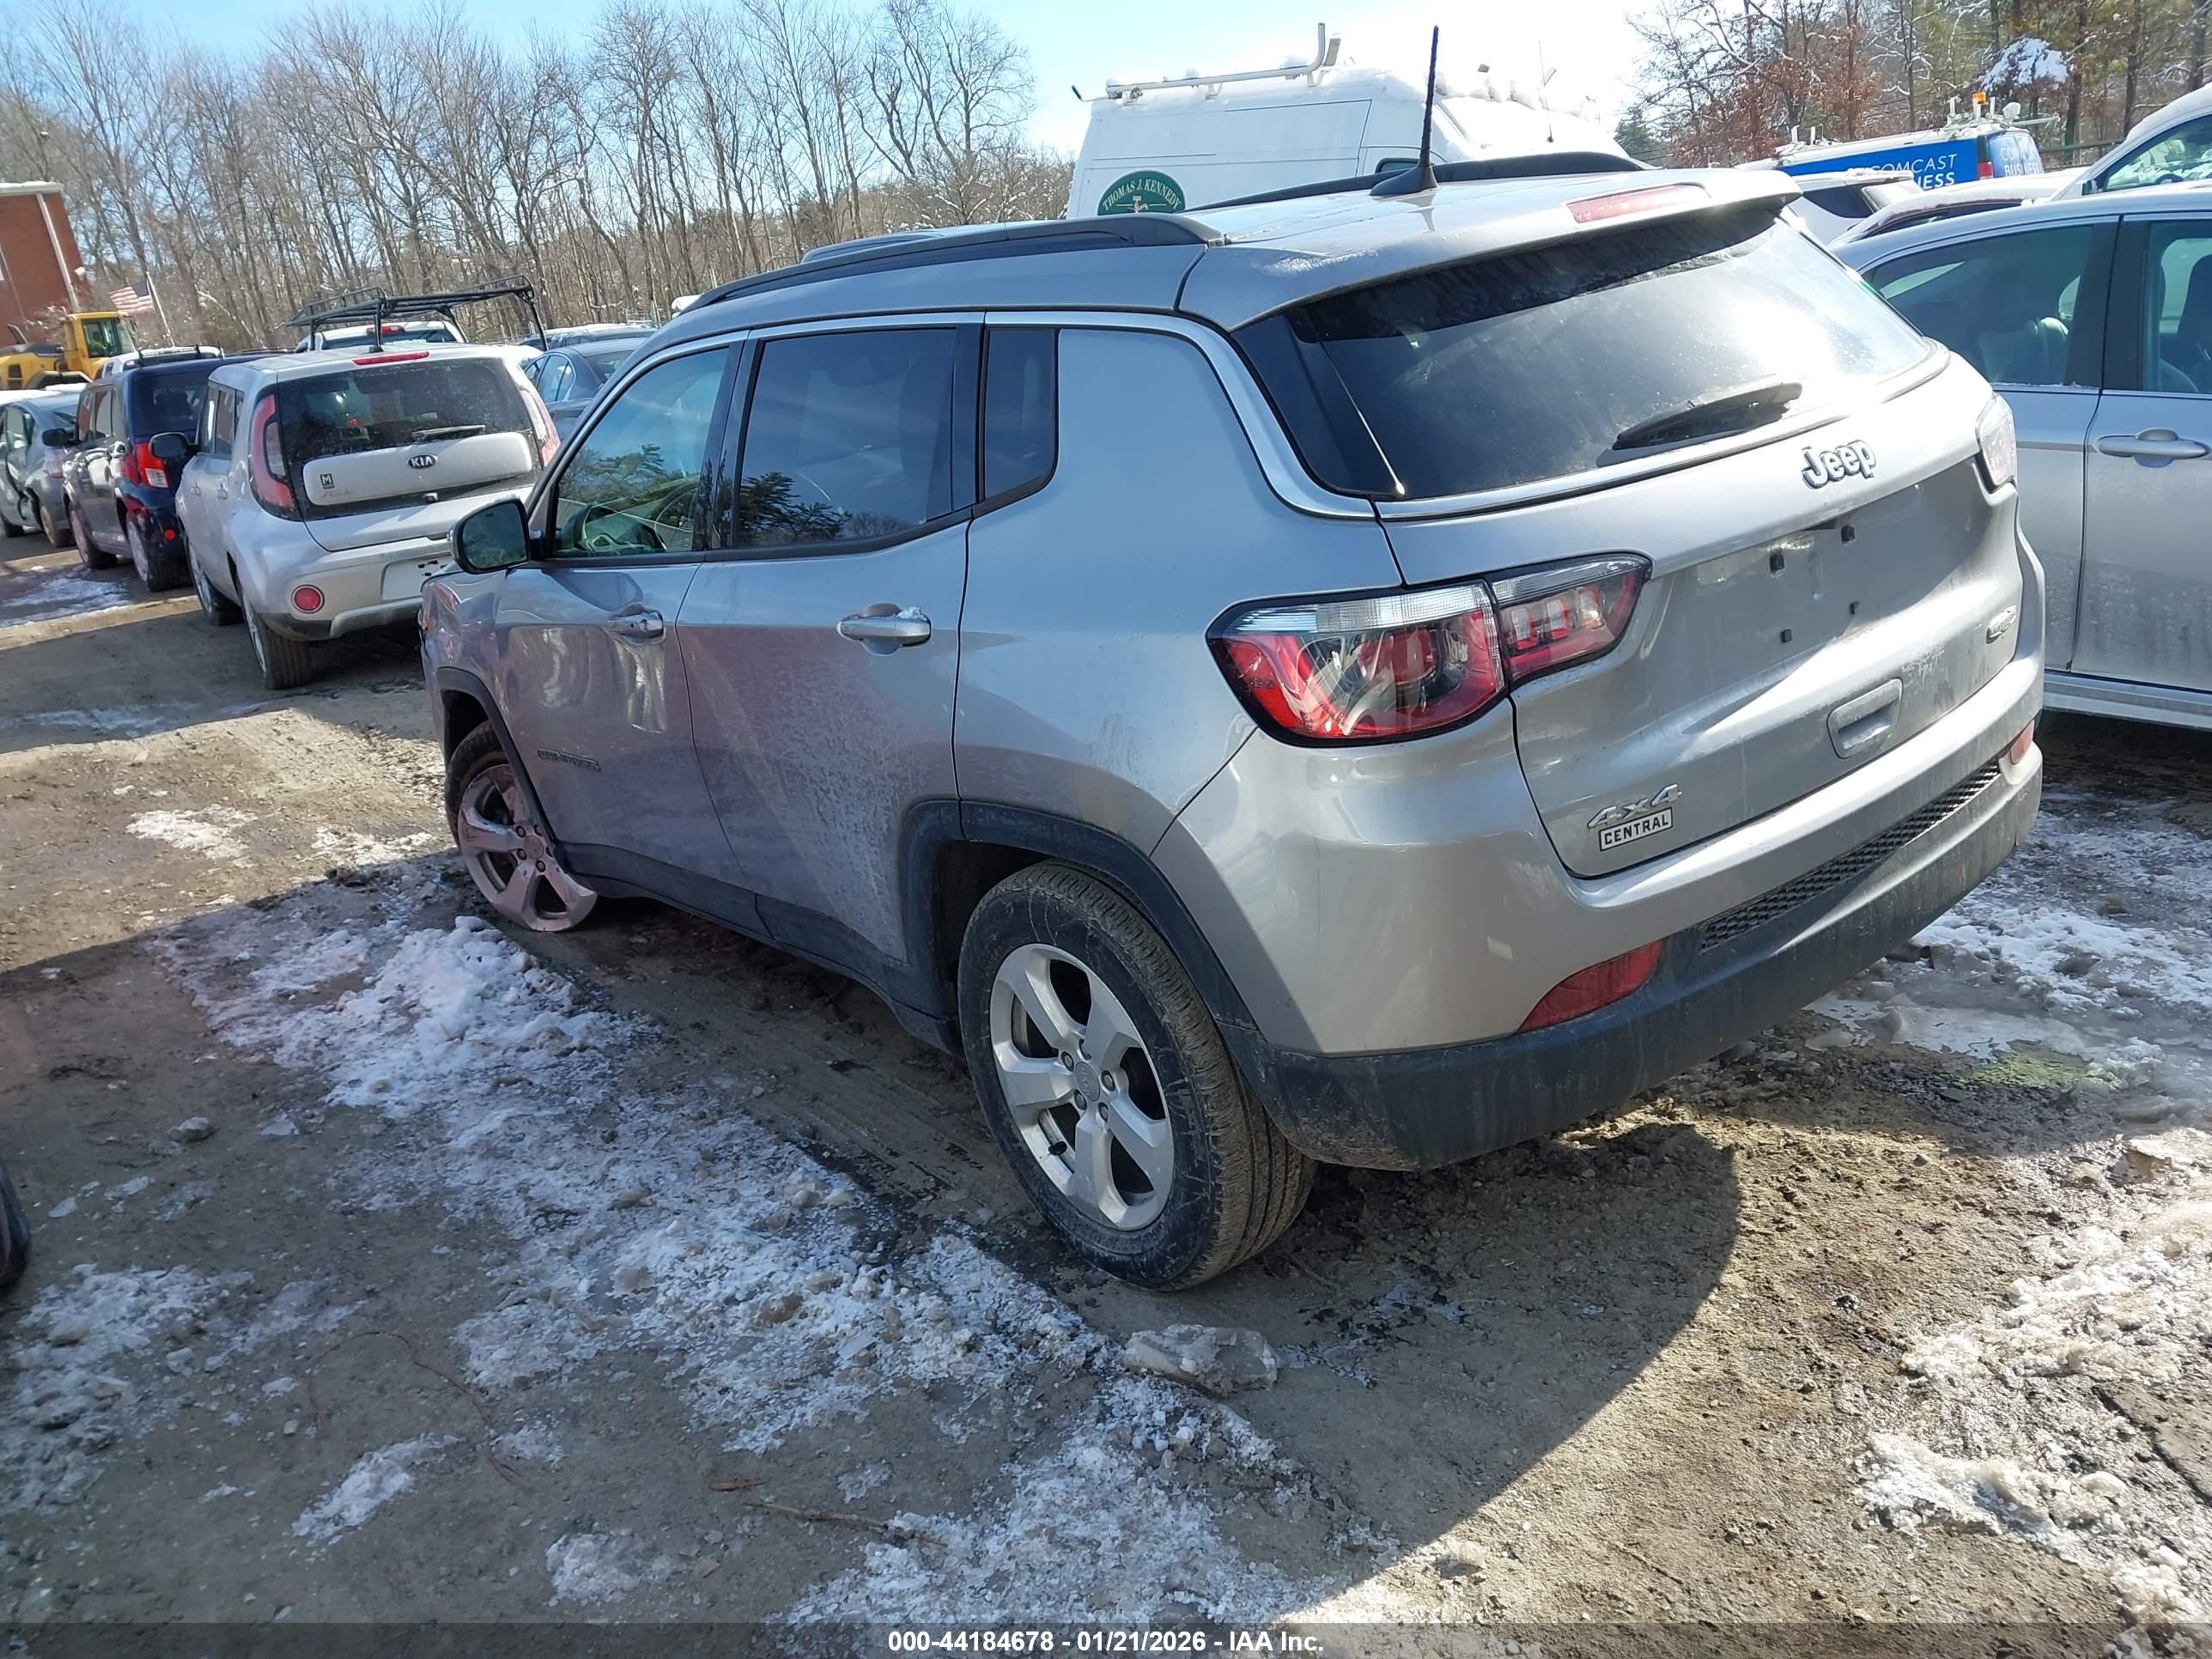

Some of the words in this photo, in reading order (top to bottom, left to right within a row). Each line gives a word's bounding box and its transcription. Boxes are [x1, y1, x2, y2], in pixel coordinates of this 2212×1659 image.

[1103, 180, 1135, 211] THOMAS
[1137, 179, 1143, 191] J.
[1144, 178, 1182, 210] KENNEDY
[410, 457, 434, 468] KIA
[1801, 439, 1876, 489] Jeep
[1587, 783, 1683, 830] 4x4
[1604, 814, 1669, 846] CENTRAL
